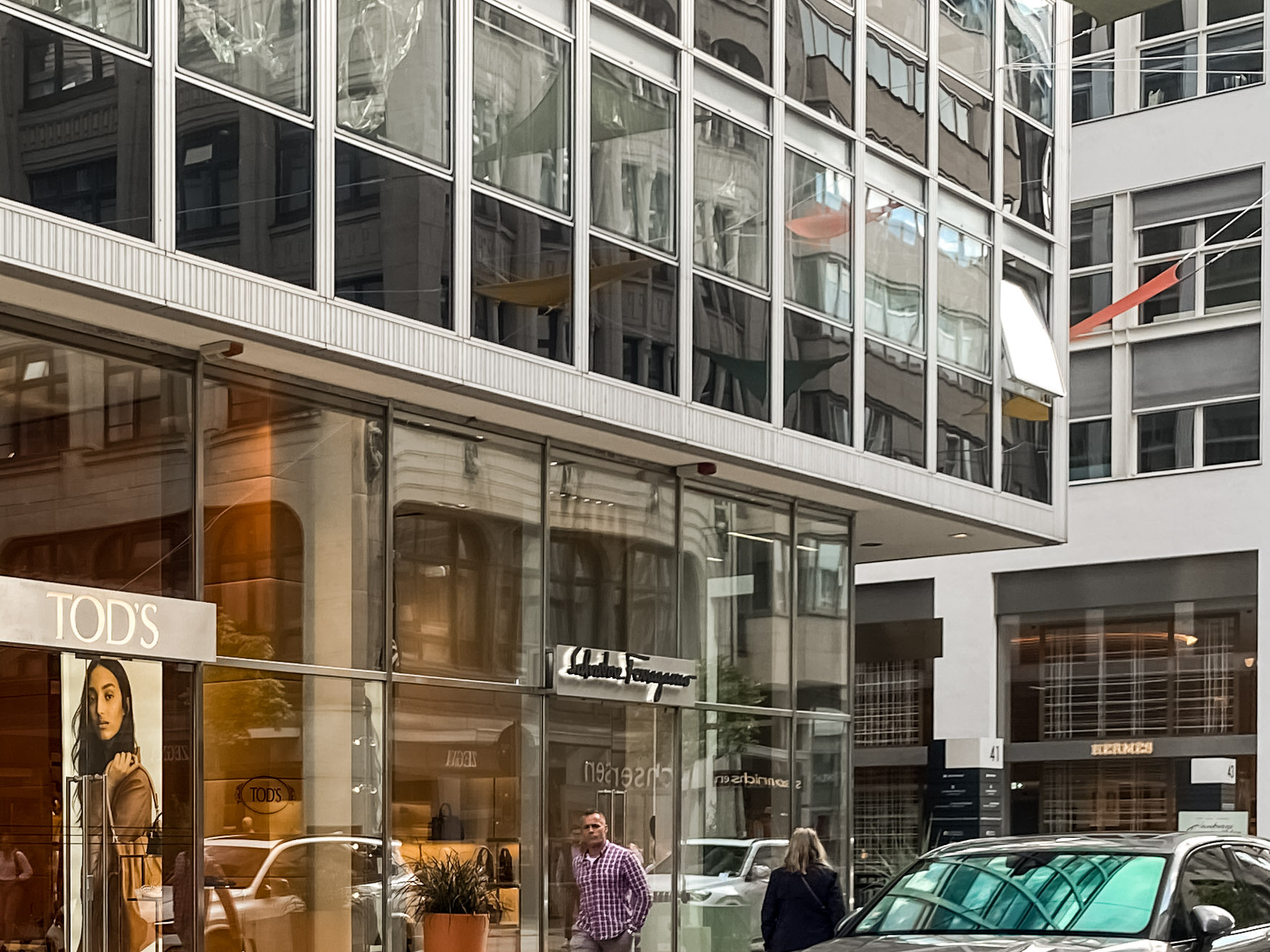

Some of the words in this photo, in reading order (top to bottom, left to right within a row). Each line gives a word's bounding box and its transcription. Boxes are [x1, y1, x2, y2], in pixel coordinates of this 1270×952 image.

[45, 591, 160, 650] TOD'S
[989, 745, 1000, 762] 41
[249, 786, 282, 804] TOD'S
